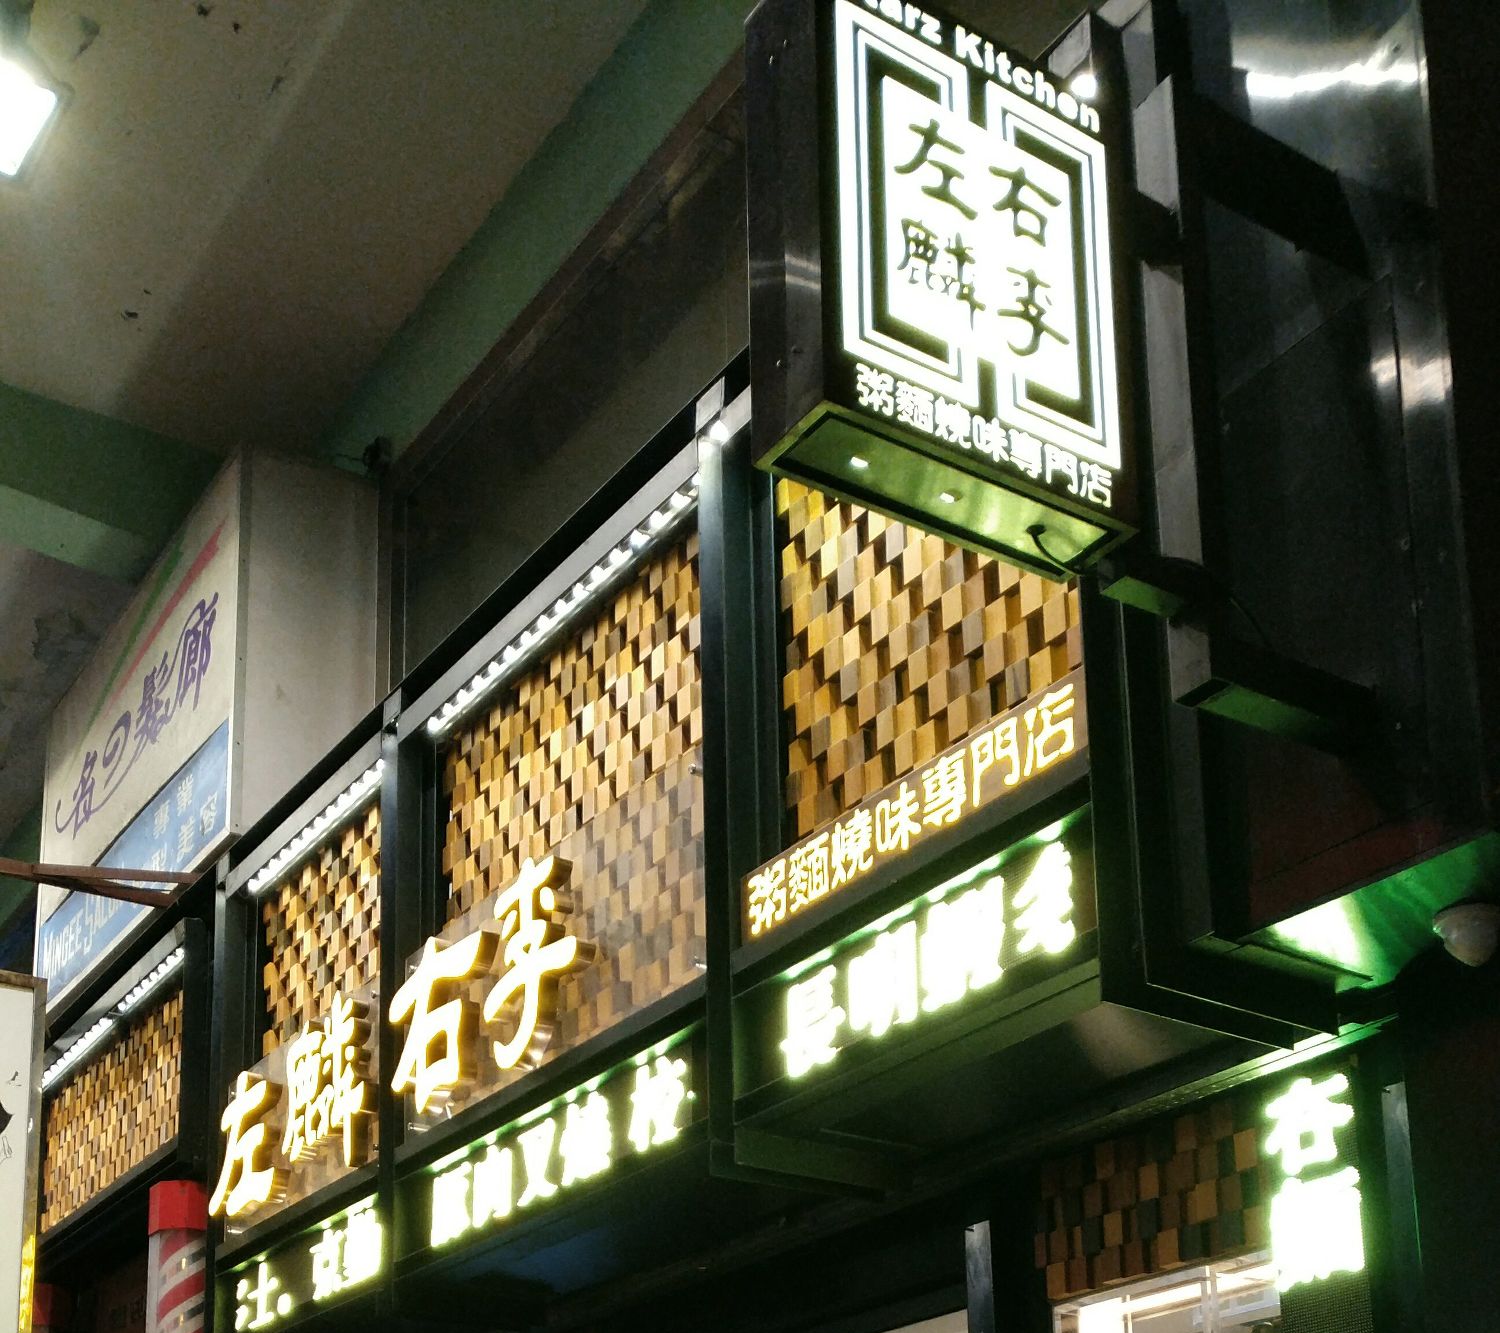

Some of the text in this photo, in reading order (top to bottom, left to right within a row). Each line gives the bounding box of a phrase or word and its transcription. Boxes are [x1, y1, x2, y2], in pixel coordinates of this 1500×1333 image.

[864, 0, 1101, 134] arz Kitchen
[855, 361, 1113, 508] 粥麵燒味專門店
[746, 683, 1076, 937] 粥麵燒味專門店
